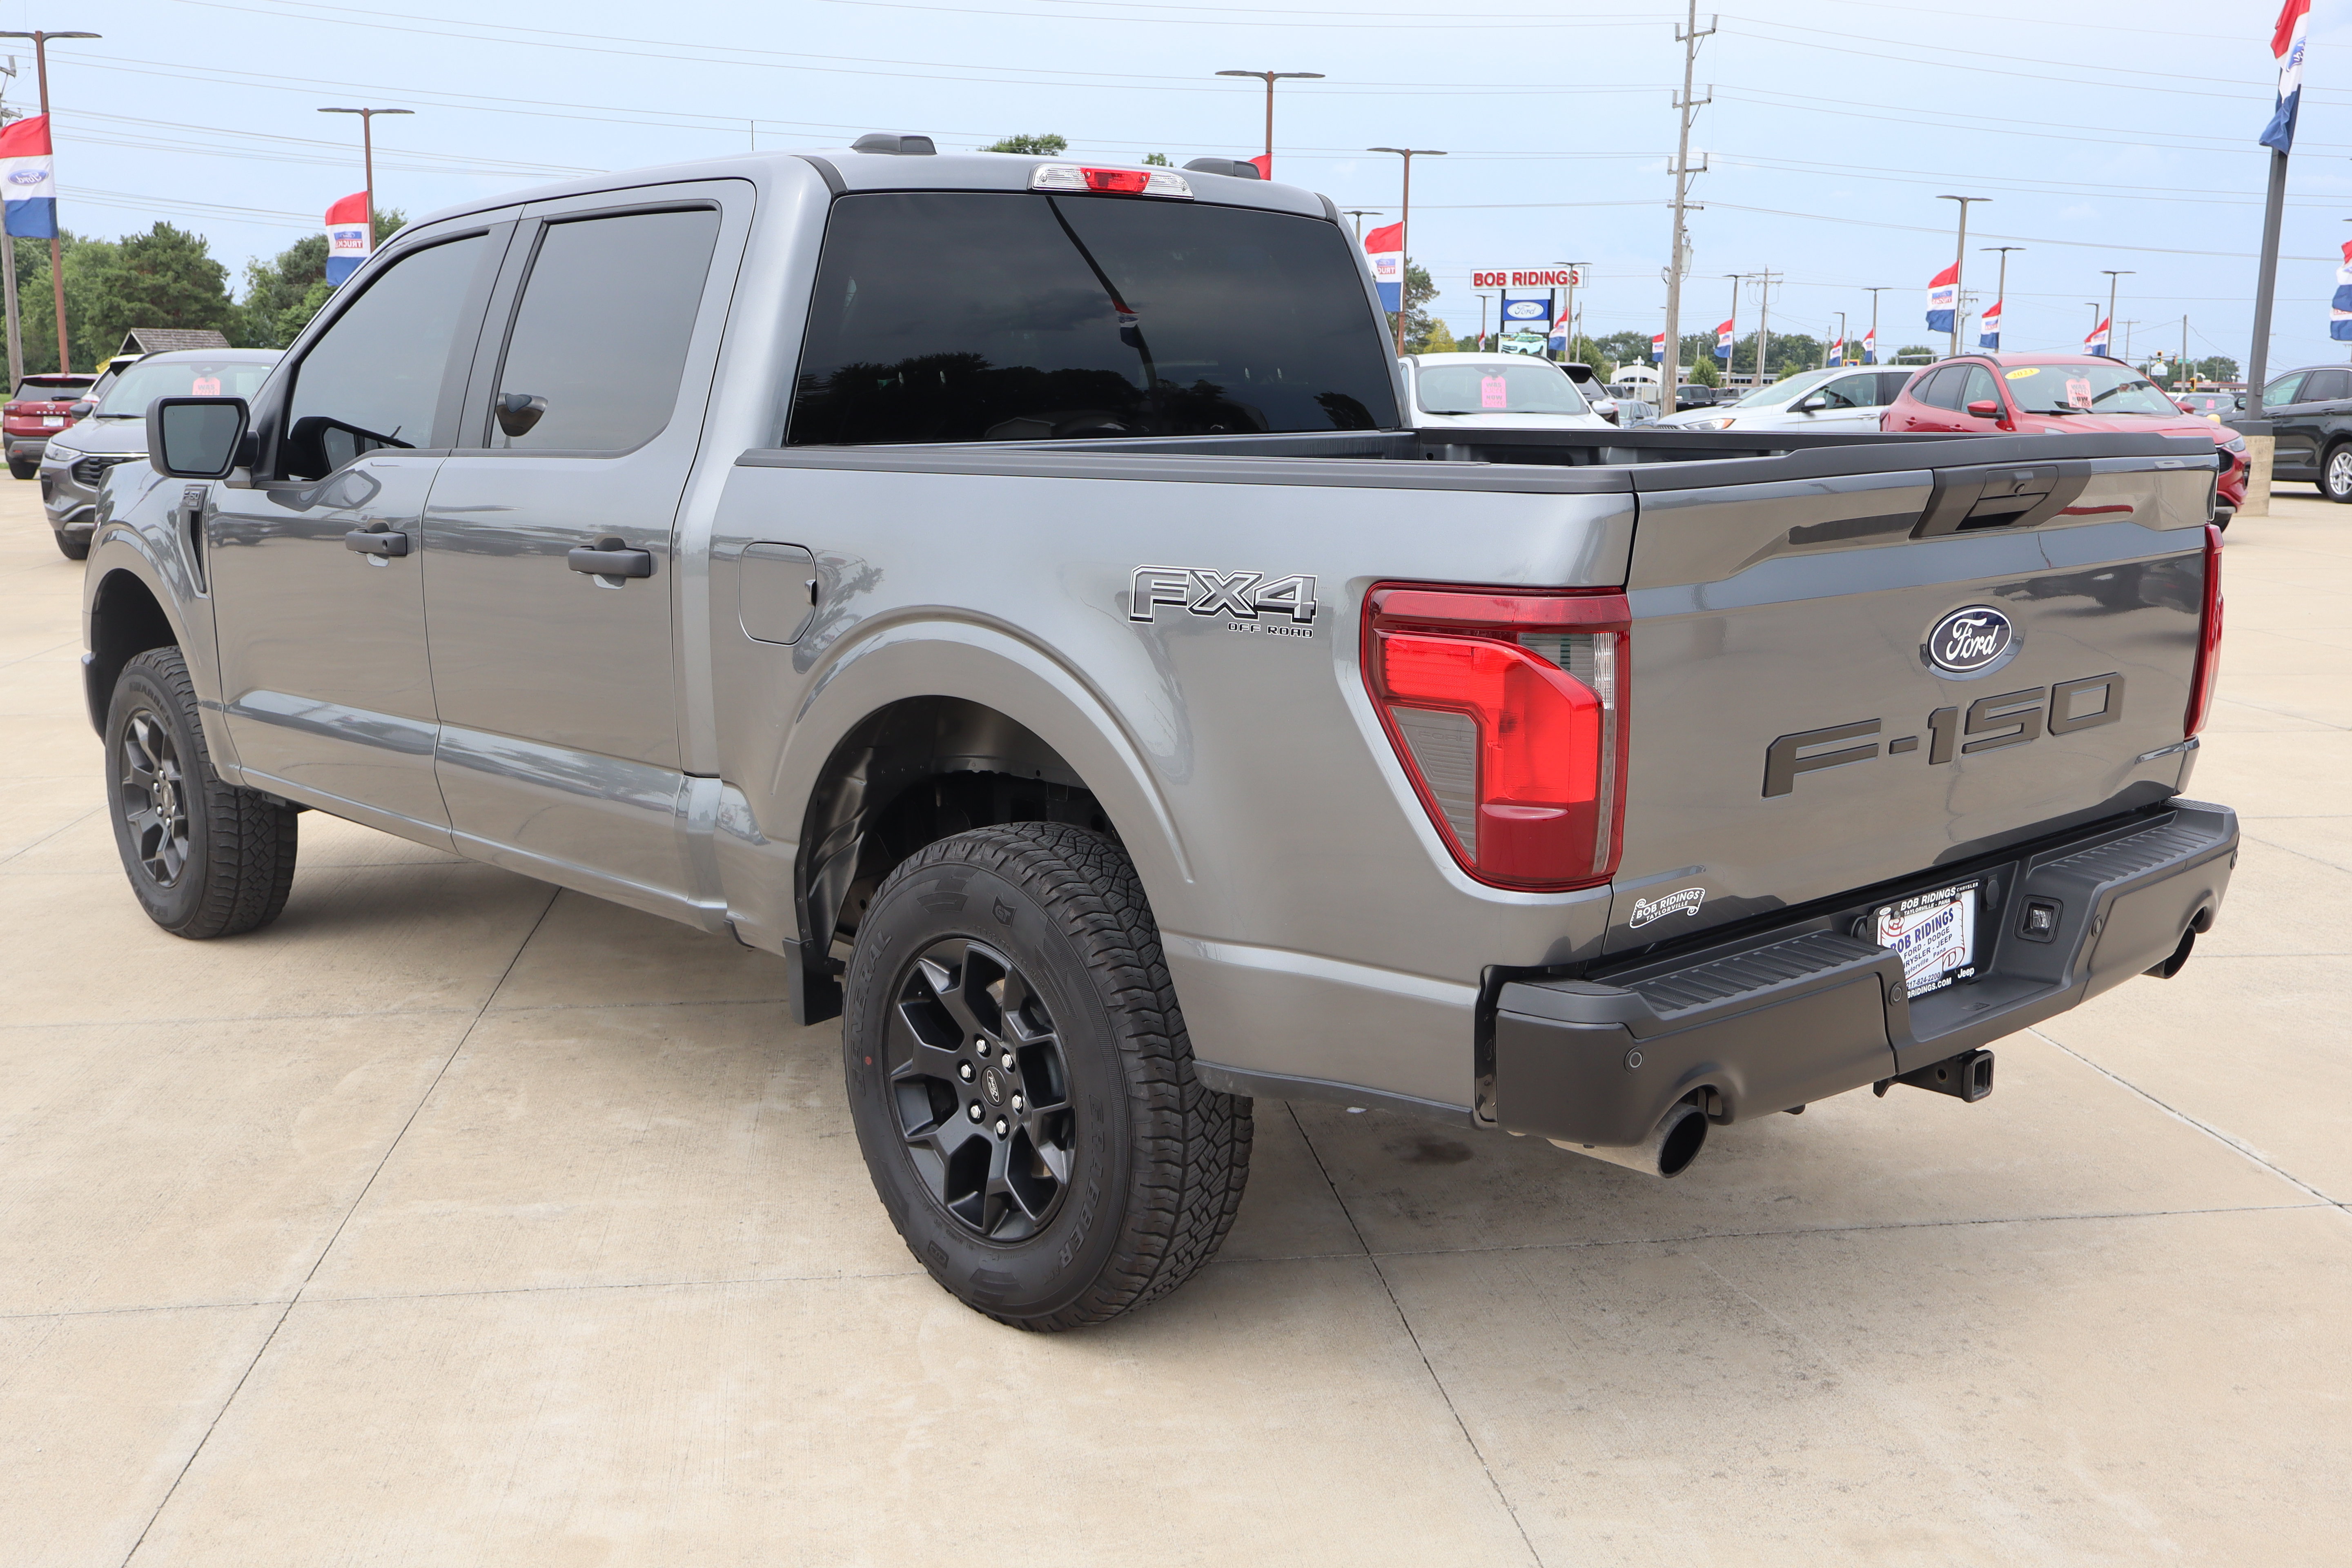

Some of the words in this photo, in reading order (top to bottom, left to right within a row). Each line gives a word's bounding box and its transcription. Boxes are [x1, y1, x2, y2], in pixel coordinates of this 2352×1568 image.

[1474, 272, 1506, 286] BOB
[1512, 270, 1579, 285] RIDINGS
[1515, 304, 1535, 315] Ford
[2011, 369, 2034, 378] 2023
[1128, 564, 1318, 626] FX4
[1227, 622, 1261, 633] OFF
[1267, 625, 1314, 639] ROAD
[1945, 616, 2000, 661] Ford
[1761, 672, 2125, 801] F-150
[1957, 882, 1979, 892] CHRYSLER
[1636, 904, 1657, 919] BOB
[1660, 890, 1700, 909] RIDINGS
[1900, 897, 1919, 911] BOB
[1921, 886, 1956, 905] RIDINGS
[1646, 900, 1689, 921] TAYLORVILLE
[1904, 903, 1934, 916] TAYLORVILLE
[1914, 907, 1954, 944] RIDINGS
[1904, 944, 1922, 960] FORD
[1927, 926, 1950, 945] DODGE
[1936, 933, 1953, 949] JEEP
[1933, 947, 1946, 958] Pana
[1906, 972, 1940, 989] 217-824-2200
[1958, 967, 1975, 979] Jeep
[988, 1076, 998, 1096] Ford
